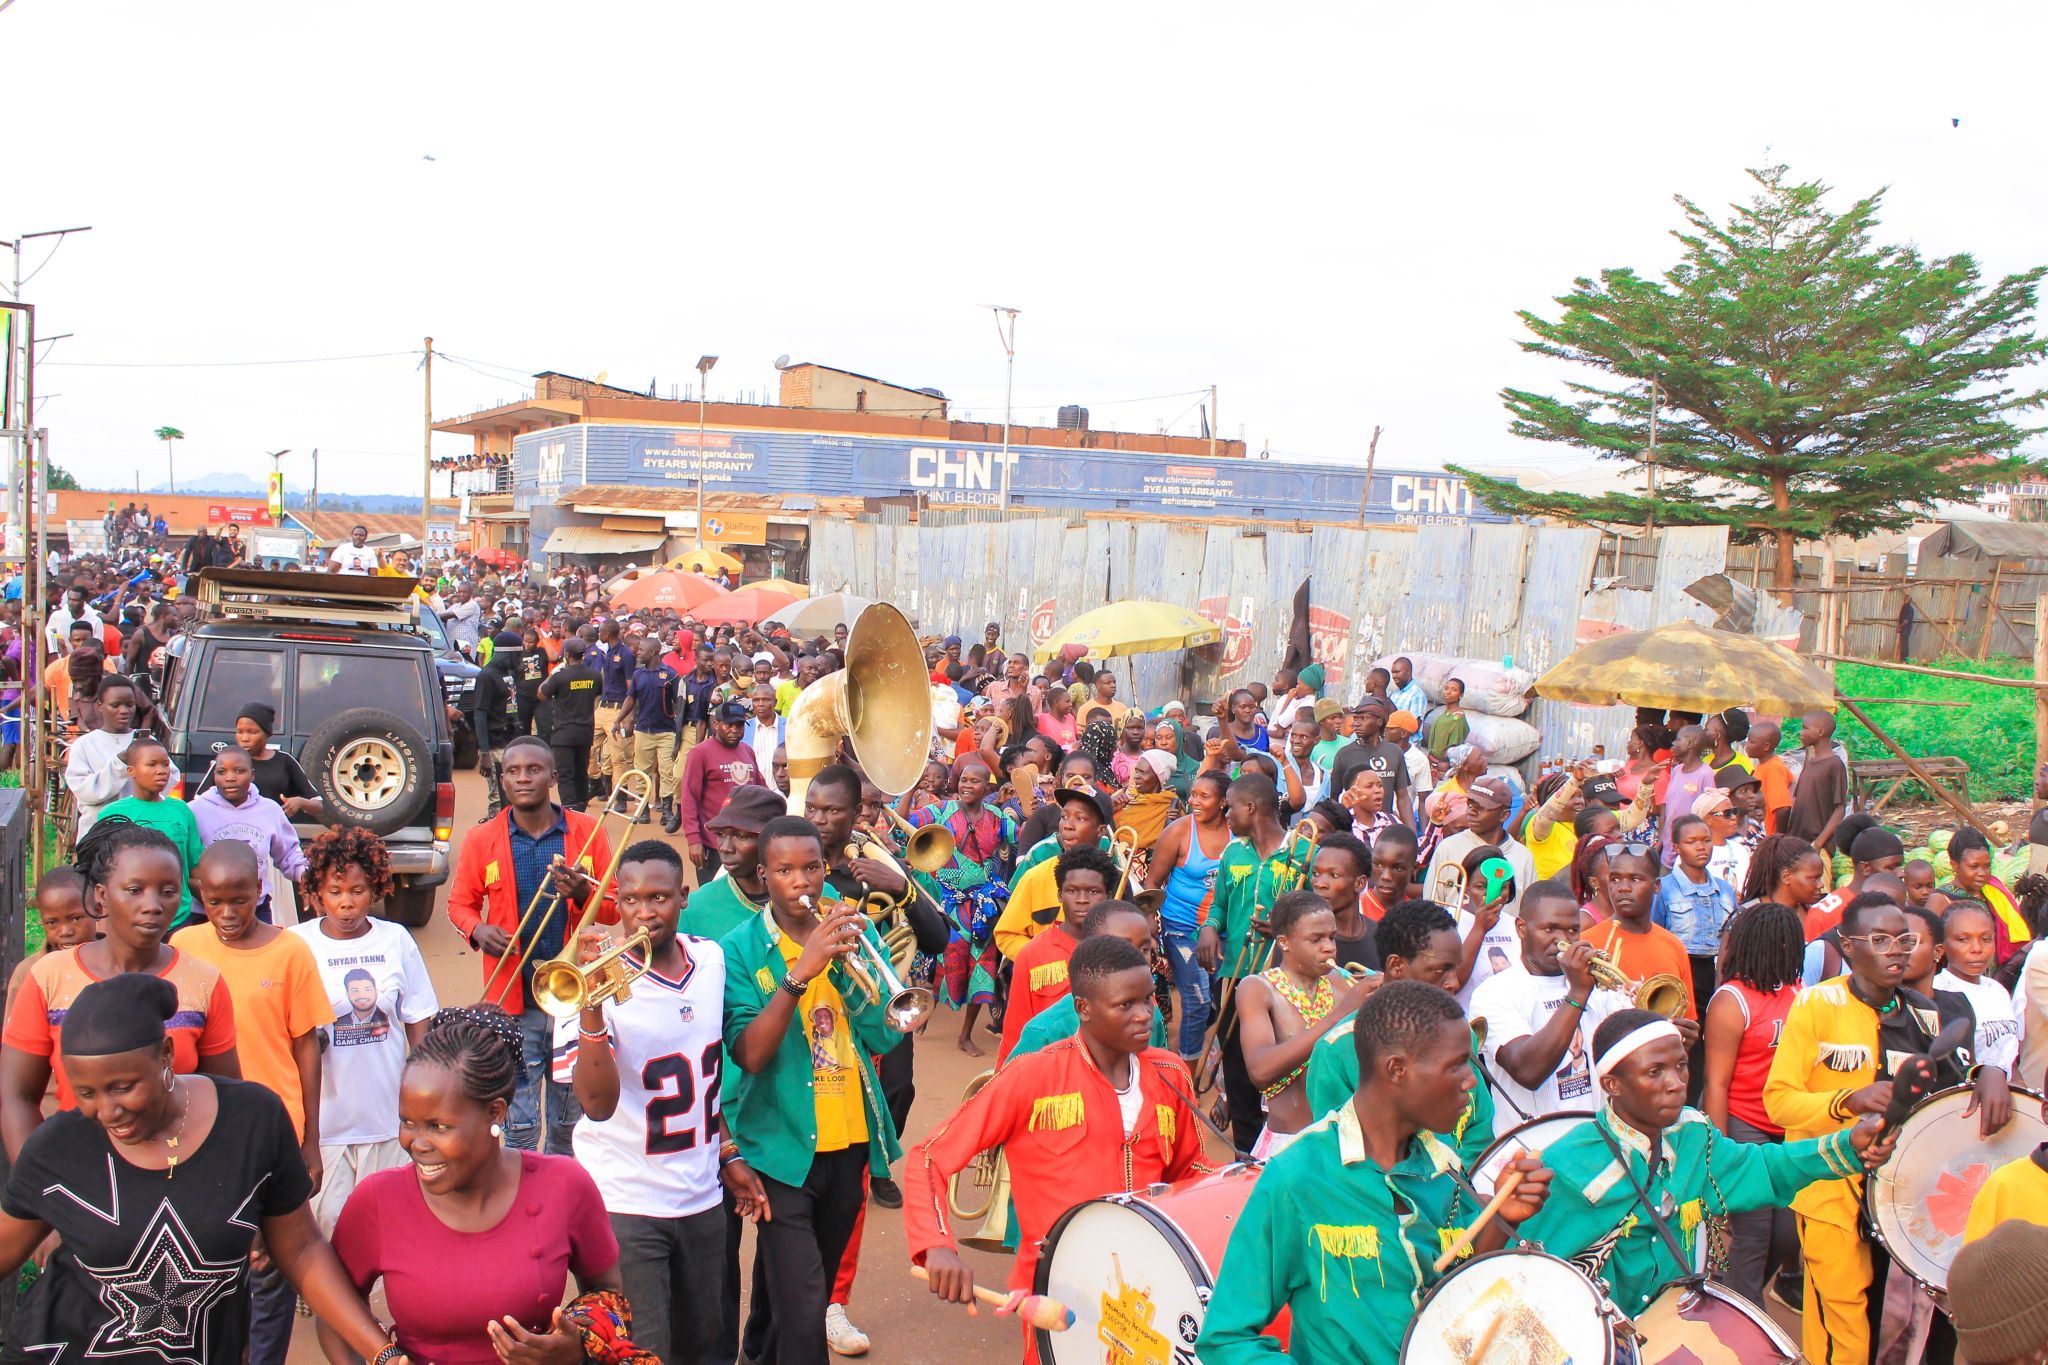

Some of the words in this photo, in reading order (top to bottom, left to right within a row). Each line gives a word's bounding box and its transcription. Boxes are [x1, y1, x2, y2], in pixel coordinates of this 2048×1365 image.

[643, 458, 688, 469] 2YEARS
[689, 460, 753, 472] WARRANTY
[664, 471, 732, 483] @chintganda
[916, 489, 951, 503] CHINT
[1143, 485, 1180, 495] 2YEARS
[1181, 486, 1234, 498] WARRANTY
[1394, 513, 1424, 525] CHINT
[1425, 515, 1468, 527] ELECTRIC
[570, 680, 594, 690] SECURITY
[327, 956, 358, 967] SHYAM
[359, 954, 386, 964] TANNA
[1561, 1088, 1582, 1099] GAME
